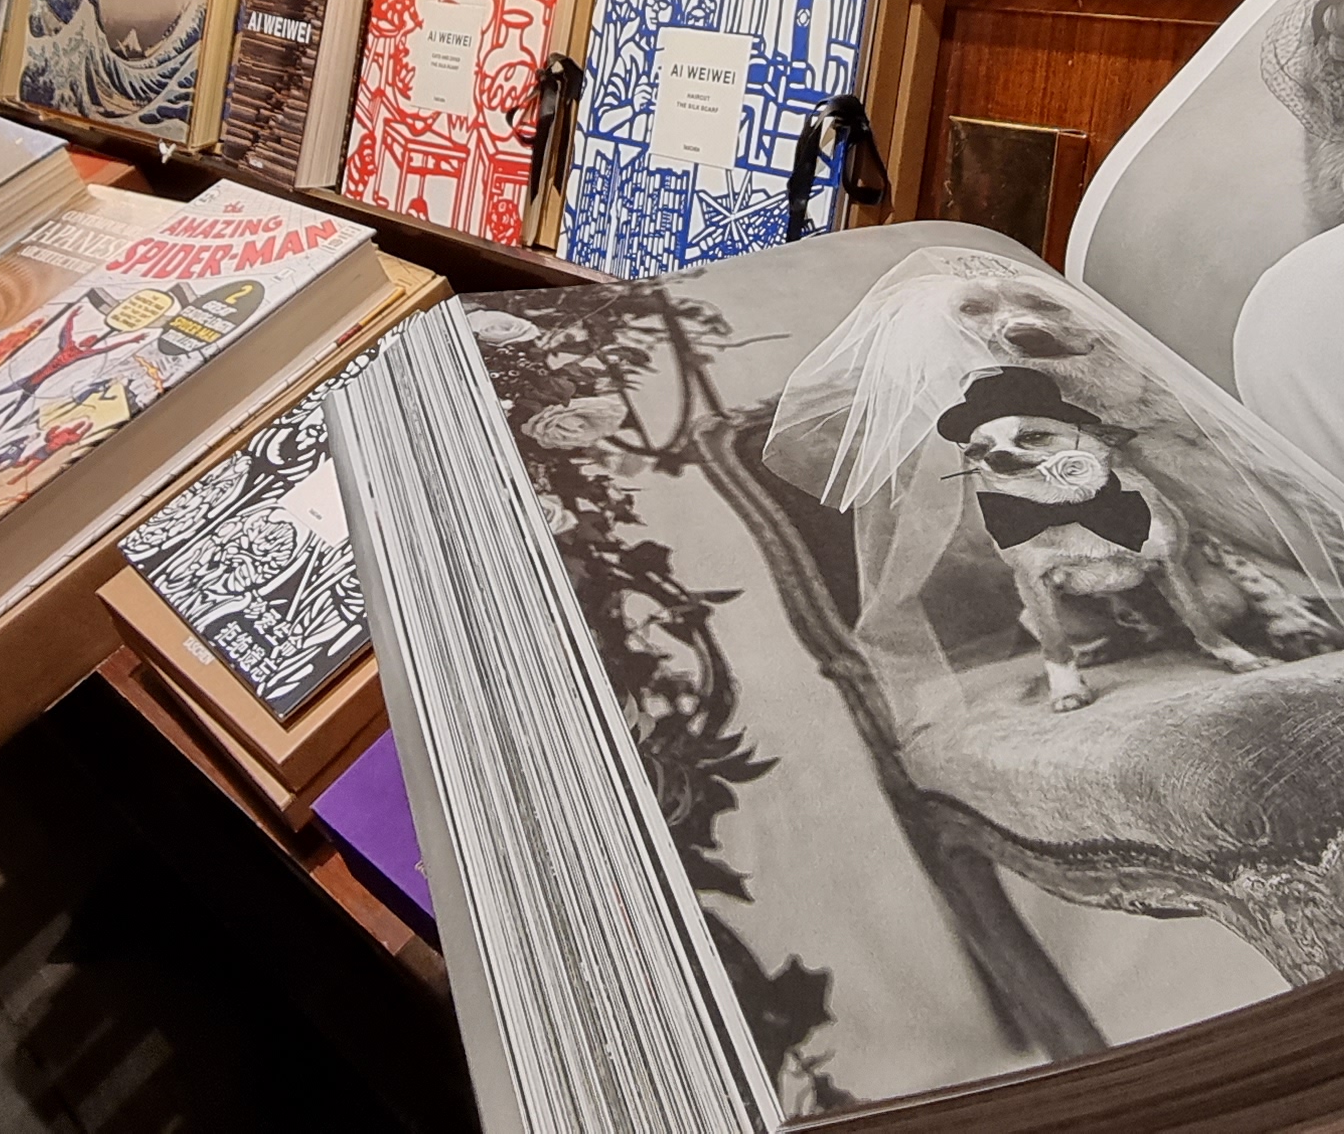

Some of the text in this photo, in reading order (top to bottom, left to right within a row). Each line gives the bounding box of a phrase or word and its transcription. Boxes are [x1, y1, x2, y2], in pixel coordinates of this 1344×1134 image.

[247, 10, 313, 44] AI WEIWEI
[427, 30, 473, 47] AI WEIWEI
[670, 63, 737, 85] AI WEIWEI
[676, 101, 687, 110] THE
[687, 102, 700, 111] SILK
[687, 93, 711, 102] HAIRCUT
[159, 215, 284, 240] AMAZING
[105, 218, 340, 281] SPIDER-MAN
[224, 284, 254, 305] 2
